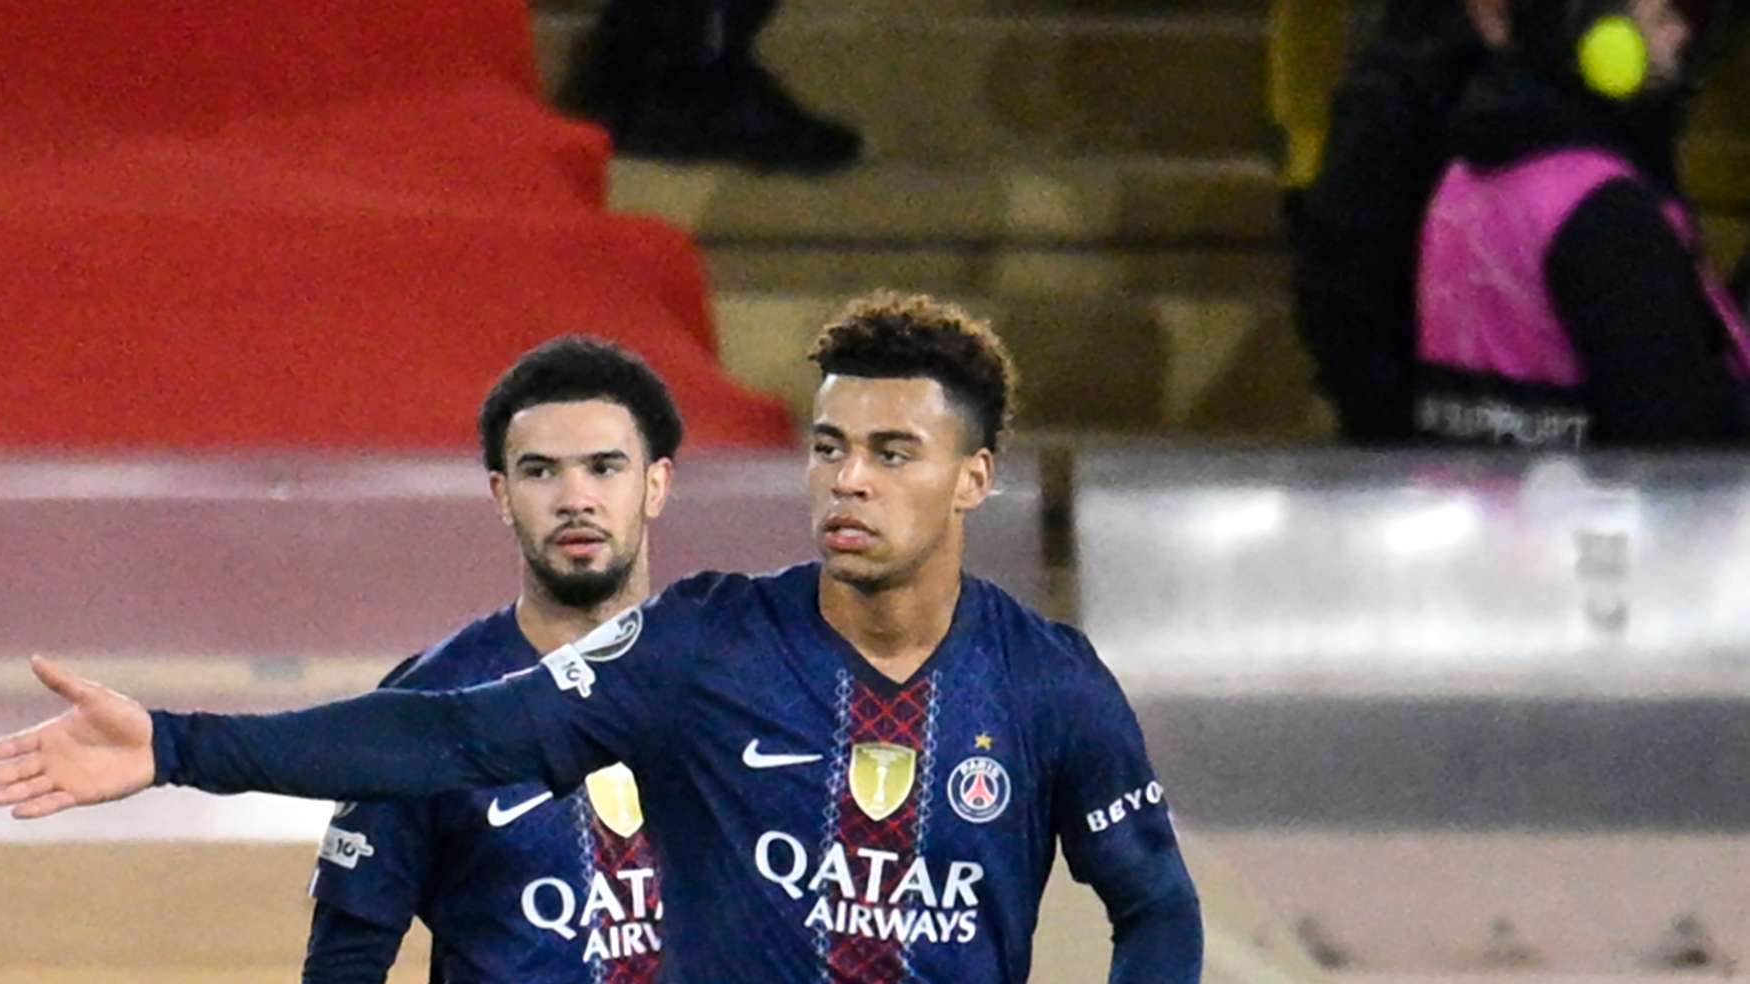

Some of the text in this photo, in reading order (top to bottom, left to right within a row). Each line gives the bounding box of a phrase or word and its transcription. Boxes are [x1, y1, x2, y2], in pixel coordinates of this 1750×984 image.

[521, 867, 664, 940] QAT
[754, 830, 984, 909] QATAR
[804, 895, 979, 946] AIRWAYS
